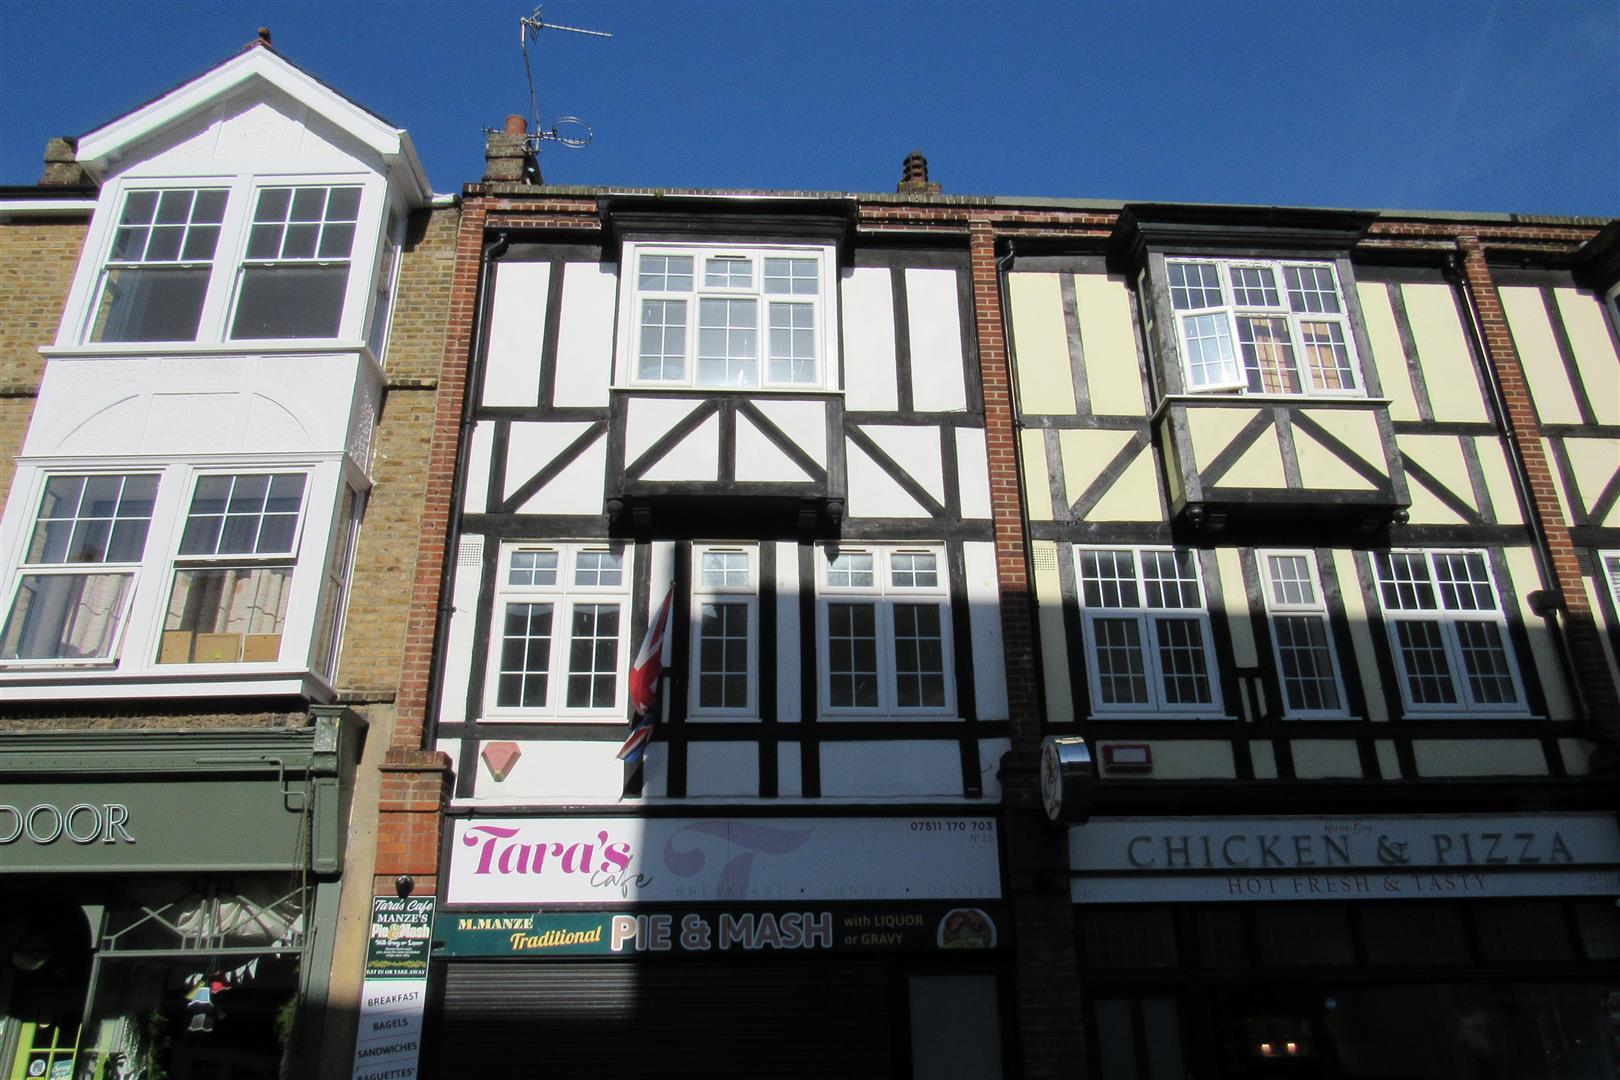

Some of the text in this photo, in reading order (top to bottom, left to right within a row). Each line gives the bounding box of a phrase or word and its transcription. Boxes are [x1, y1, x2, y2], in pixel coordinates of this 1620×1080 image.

[0, 803, 136, 844] DOOR
[910, 821, 993, 831] 07511 170 703
[462, 825, 632, 875] Tara's
[1127, 831, 1576, 867] CHICKEN & PIZZA
[590, 855, 653, 898] cafe
[1227, 873, 1488, 894] HOT FRESH & TASTY
[375, 899, 433, 914] Tara's Cafe
[377, 914, 428, 922] MANZE'S
[458, 917, 534, 930] M.MANZE
[844, 914, 924, 928] with LIQUOR
[371, 923, 388, 938] Pie
[401, 923, 430, 938] Mash
[510, 926, 601, 950] Traditional
[611, 911, 833, 951] PIE & MASH
[844, 933, 904, 946] or GRAVY
[368, 992, 419, 1006] BREAKFAST
[374, 1018, 408, 1031] BAGELS
[357, 1042, 417, 1059] SANDWICHES
